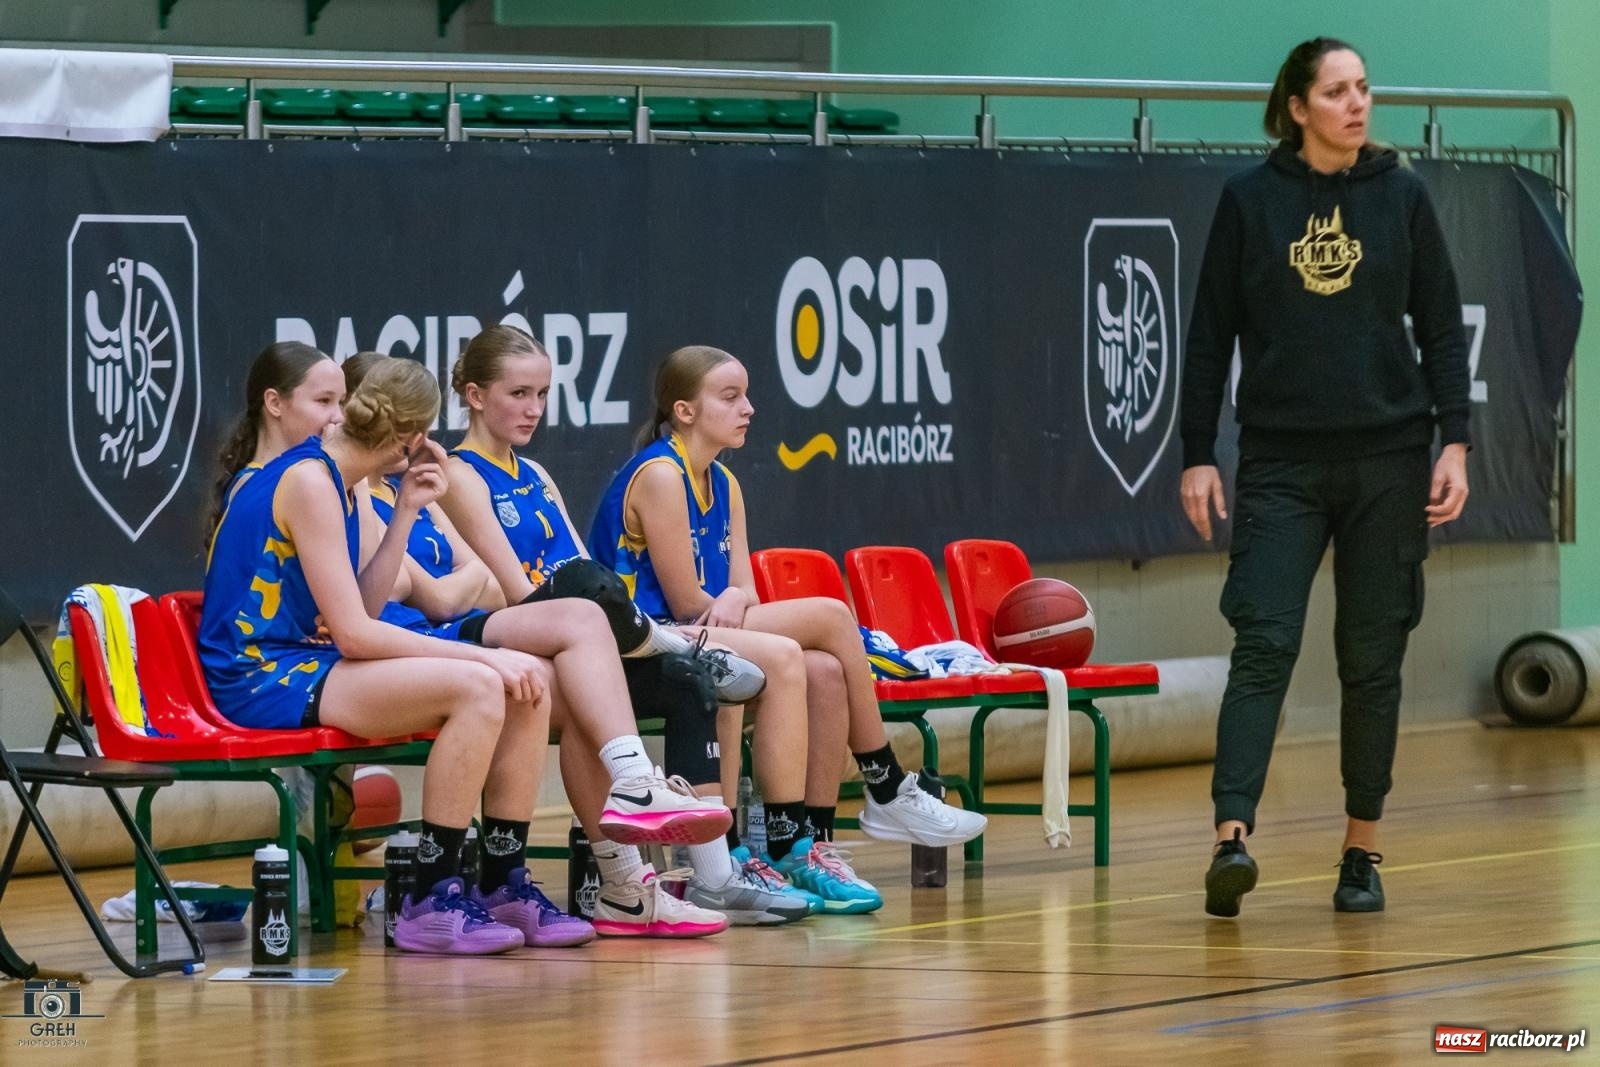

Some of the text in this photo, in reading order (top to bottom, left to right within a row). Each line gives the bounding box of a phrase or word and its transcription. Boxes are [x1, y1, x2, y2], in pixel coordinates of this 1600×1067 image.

[1293, 240, 1360, 263] RMKS
[275, 269, 630, 431] IBRZ
[776, 256, 952, 408] OSiR
[847, 411, 954, 466] RACIBÓRZ
